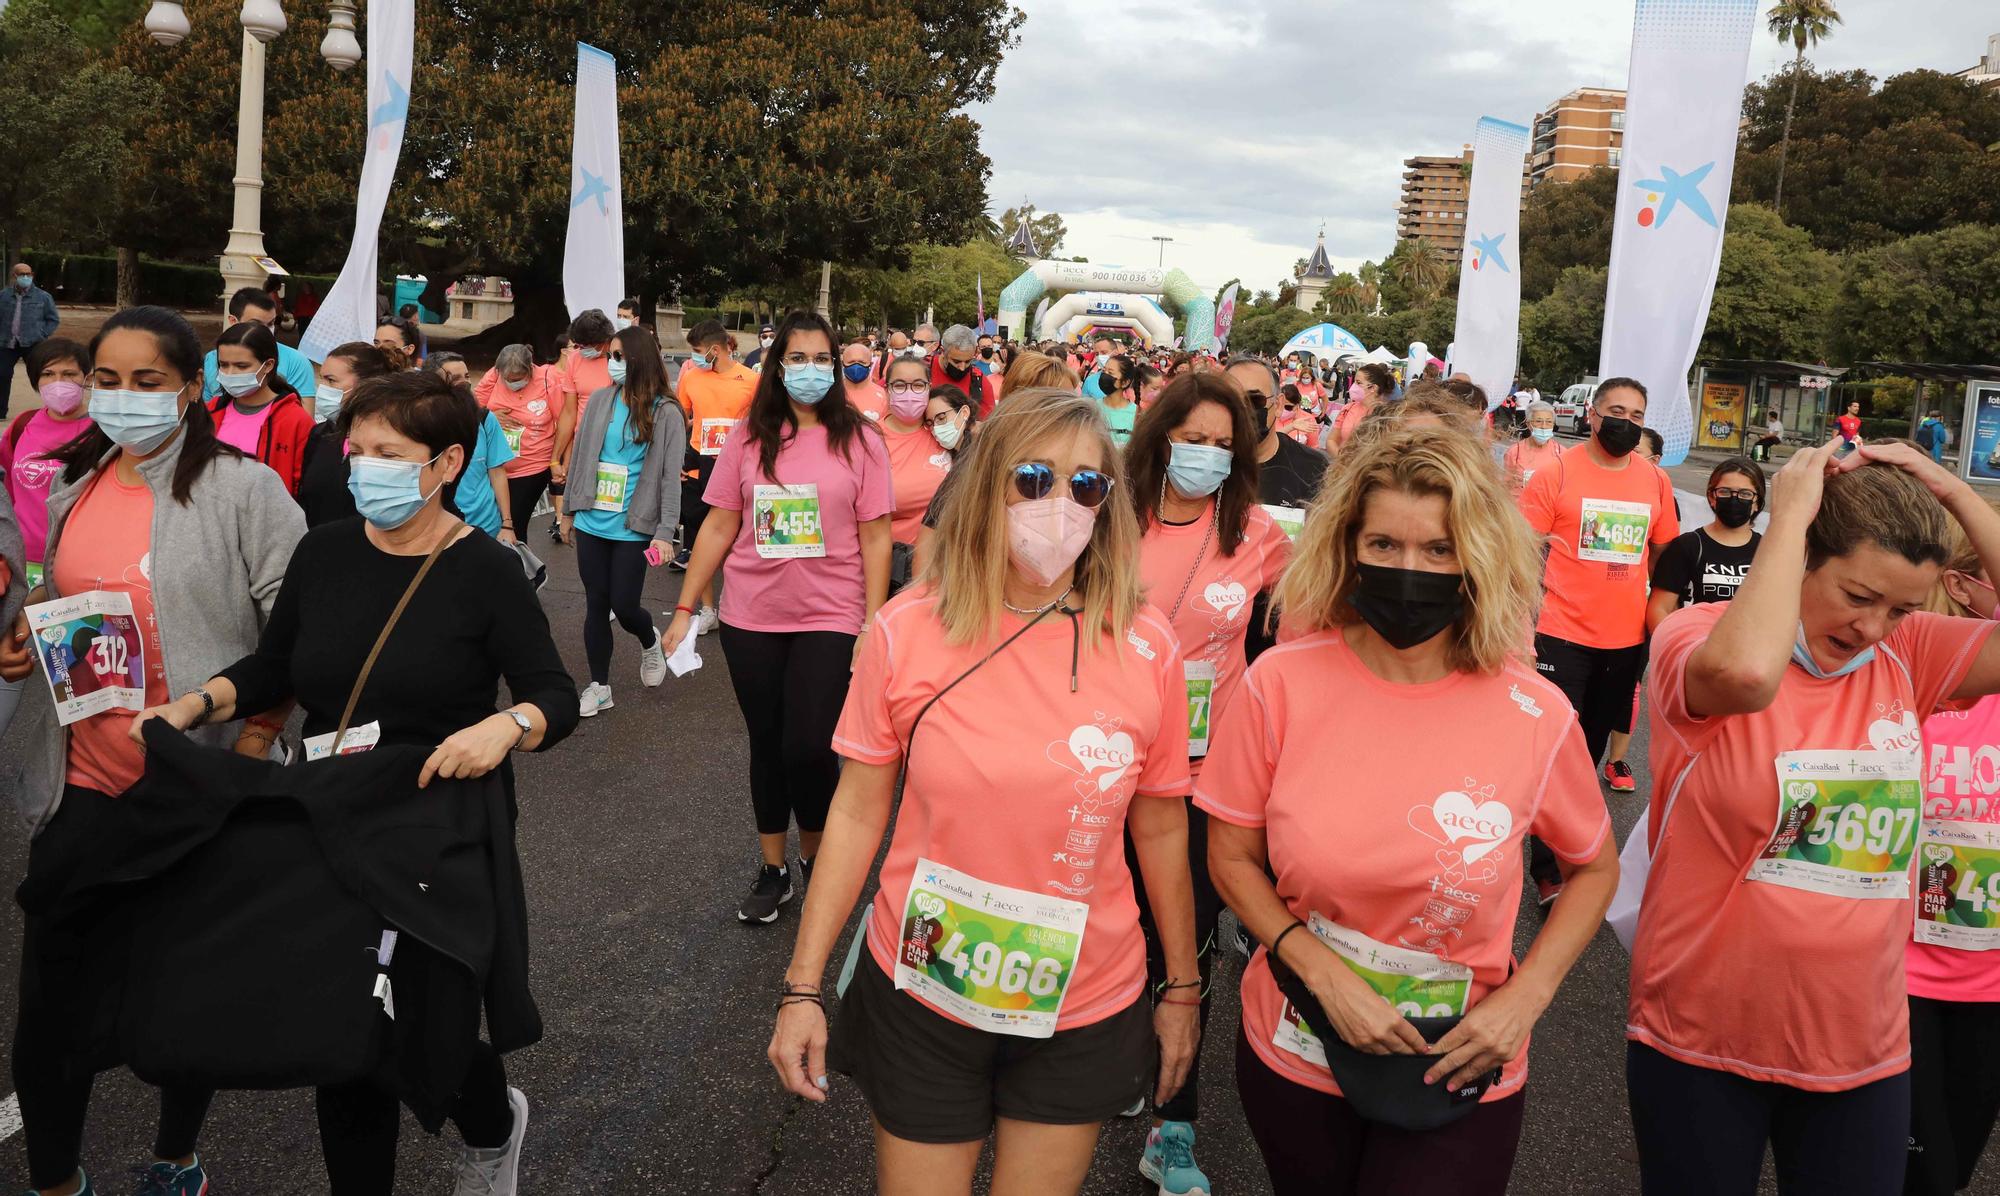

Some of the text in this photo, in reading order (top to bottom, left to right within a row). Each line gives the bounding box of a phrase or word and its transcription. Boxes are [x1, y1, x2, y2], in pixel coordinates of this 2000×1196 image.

[1092, 271, 1109, 280] 900
[1112, 273, 1127, 281] 100
[1129, 274, 1146, 282] 036
[1598, 522, 1644, 546] 4692
[1210, 591, 1244, 602] aecc
[91, 635, 129, 675] 312
[1079, 744, 1129, 765] aecc
[1802, 760, 1840, 771] CaixaBank
[1860, 763, 1884, 772] aecc
[1082, 813, 1110, 824] aecc
[1443, 811, 1505, 838] aecc
[1807, 803, 1915, 855] 5697
[1941, 830, 1977, 841] CaixaBank
[938, 878, 1024, 914] CaixaBank aecc
[1443, 886, 1481, 903] aecc
[1924, 893, 1946, 906] MAR
[1924, 903, 1946, 915] CHA
[907, 943, 929, 961] MAR
[1325, 931, 1412, 970] CaixaBank aecc
[906, 952, 928, 969] CHA
[939, 932, 1062, 996] 4966
[1461, 1086, 1478, 1097] SPORT
